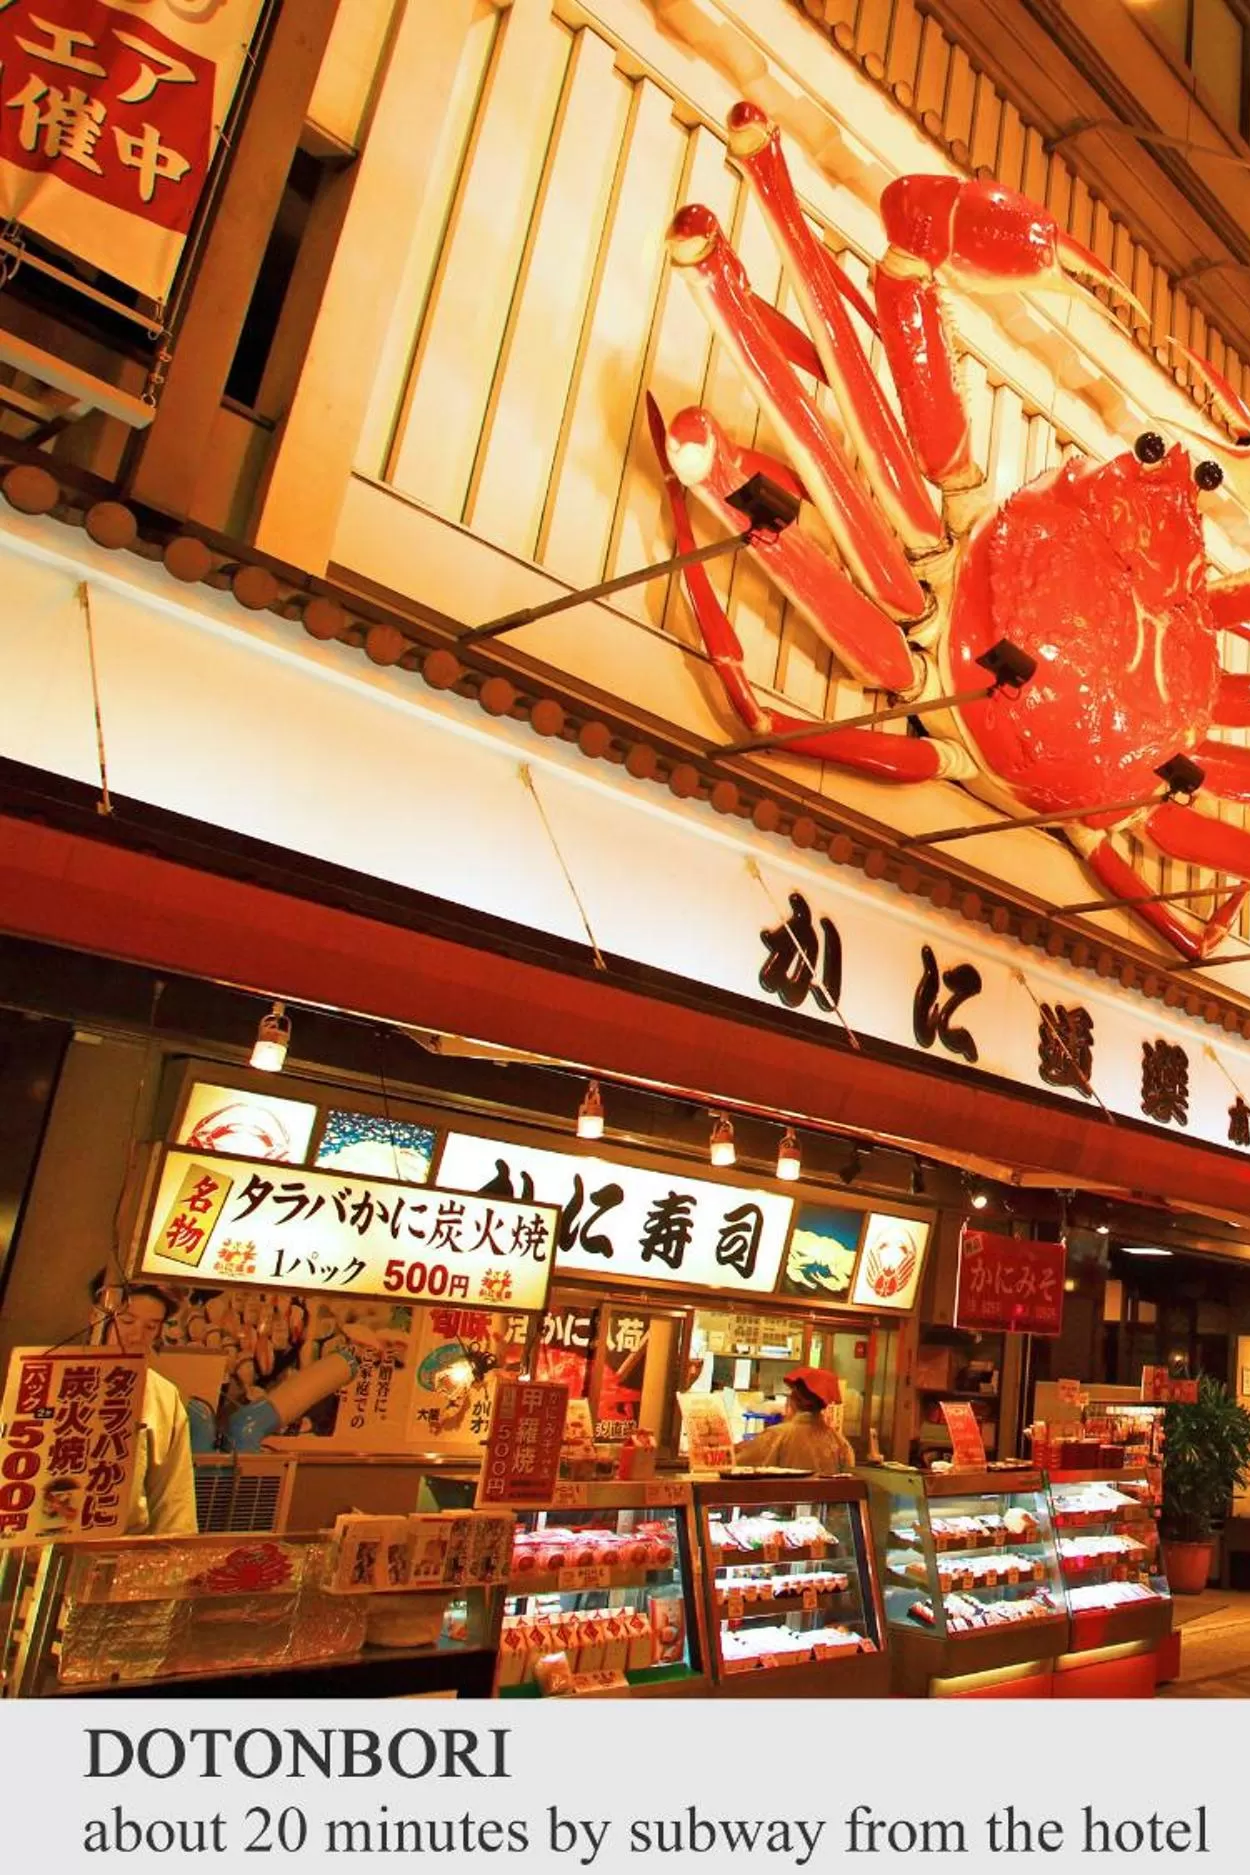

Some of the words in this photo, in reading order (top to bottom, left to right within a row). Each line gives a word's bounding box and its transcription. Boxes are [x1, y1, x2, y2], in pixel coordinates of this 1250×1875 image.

[166, 1174, 221, 1255] 名物
[231, 1172, 550, 1263] タラバかに炭火焼
[270, 1247, 368, 1287] 1パック
[383, 1259, 469, 1299] 500円
[970, 1256, 1057, 1302] かにみそ
[47, 1366, 102, 1478] 炭火焼
[79, 1366, 138, 1530] タラバかに
[0, 1420, 45, 1533] 500円
